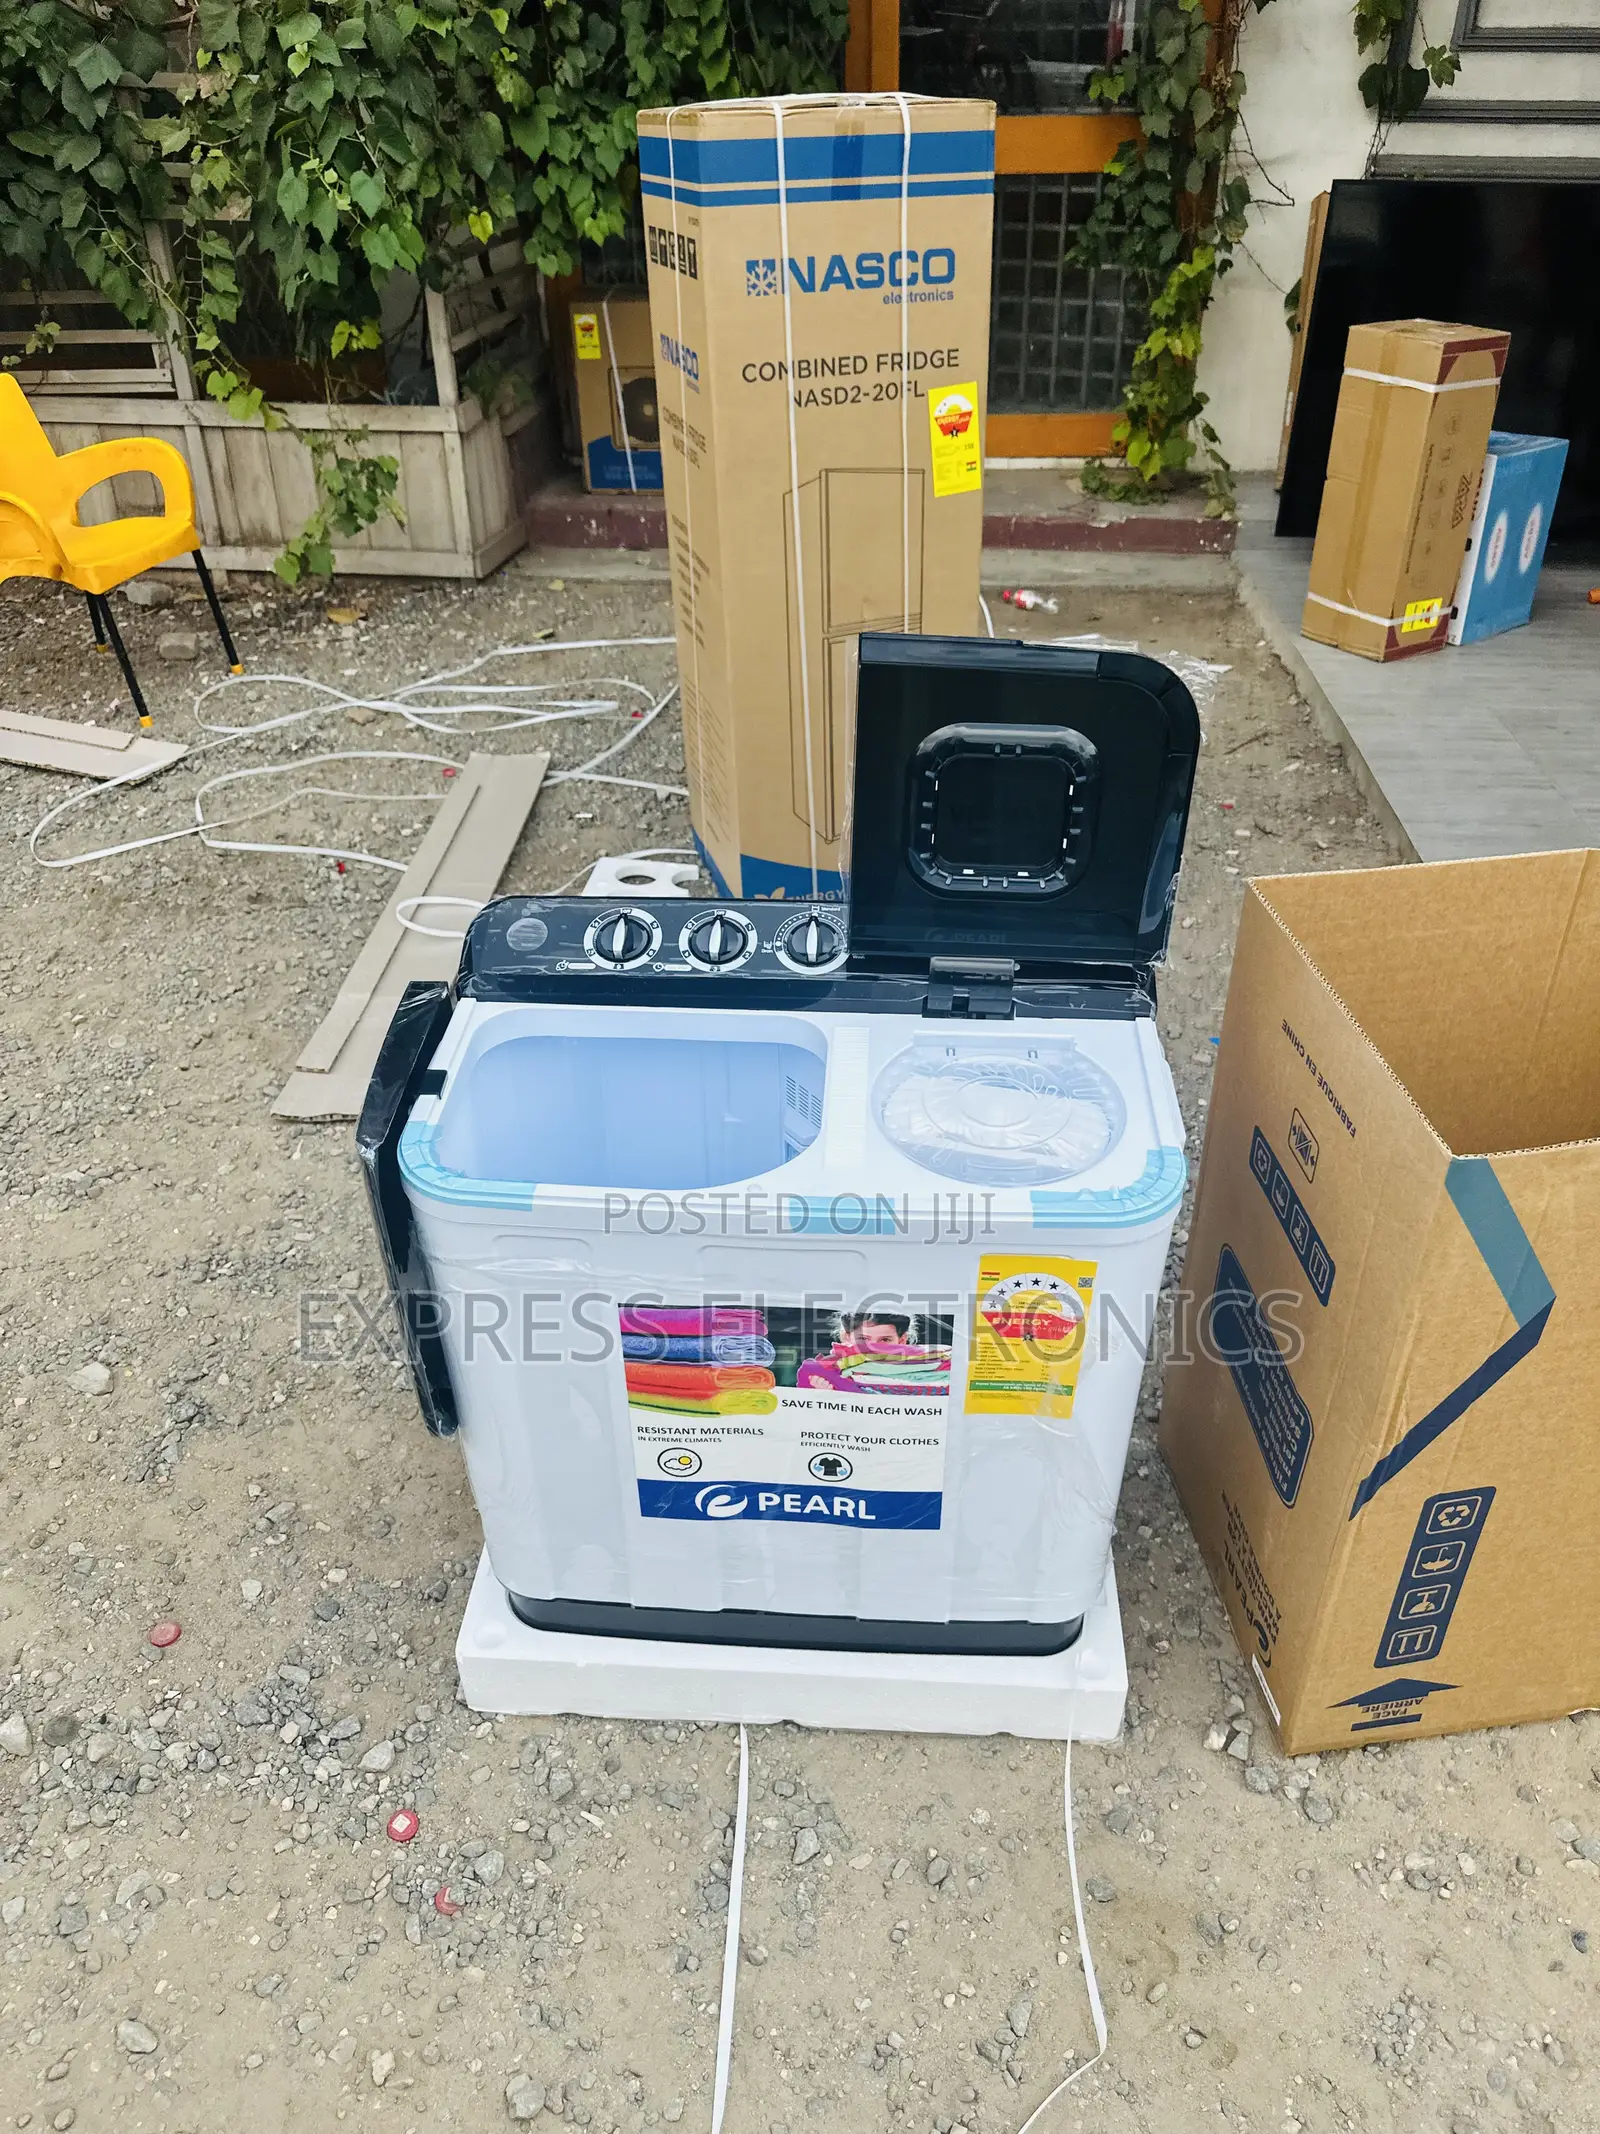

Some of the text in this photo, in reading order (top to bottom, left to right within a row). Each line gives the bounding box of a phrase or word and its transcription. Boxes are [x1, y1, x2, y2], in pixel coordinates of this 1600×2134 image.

[781, 248, 955, 294] NASCO
[883, 288, 954, 305] eletronics
[742, 348, 959, 383] COMBINED FRIDGE
[1282, 1019, 1305, 1057] CHINE
[1305, 1055, 1317, 1076] EN
[993, 1317, 1052, 1326] ENERGY
[782, 1399, 942, 1416] SAVE TIME IN EACH WASH
[637, 1426, 764, 1435] RESISTANT MATERIALS
[801, 1431, 939, 1446] PROTECT YOUR CLOTHES
[800, 1442, 846, 1450] EFFICIENTLY
[758, 1492, 876, 1520] PEARL
[1223, 1538, 1254, 1626] PEARL
[1372, 1708, 1407, 1720] FACE
